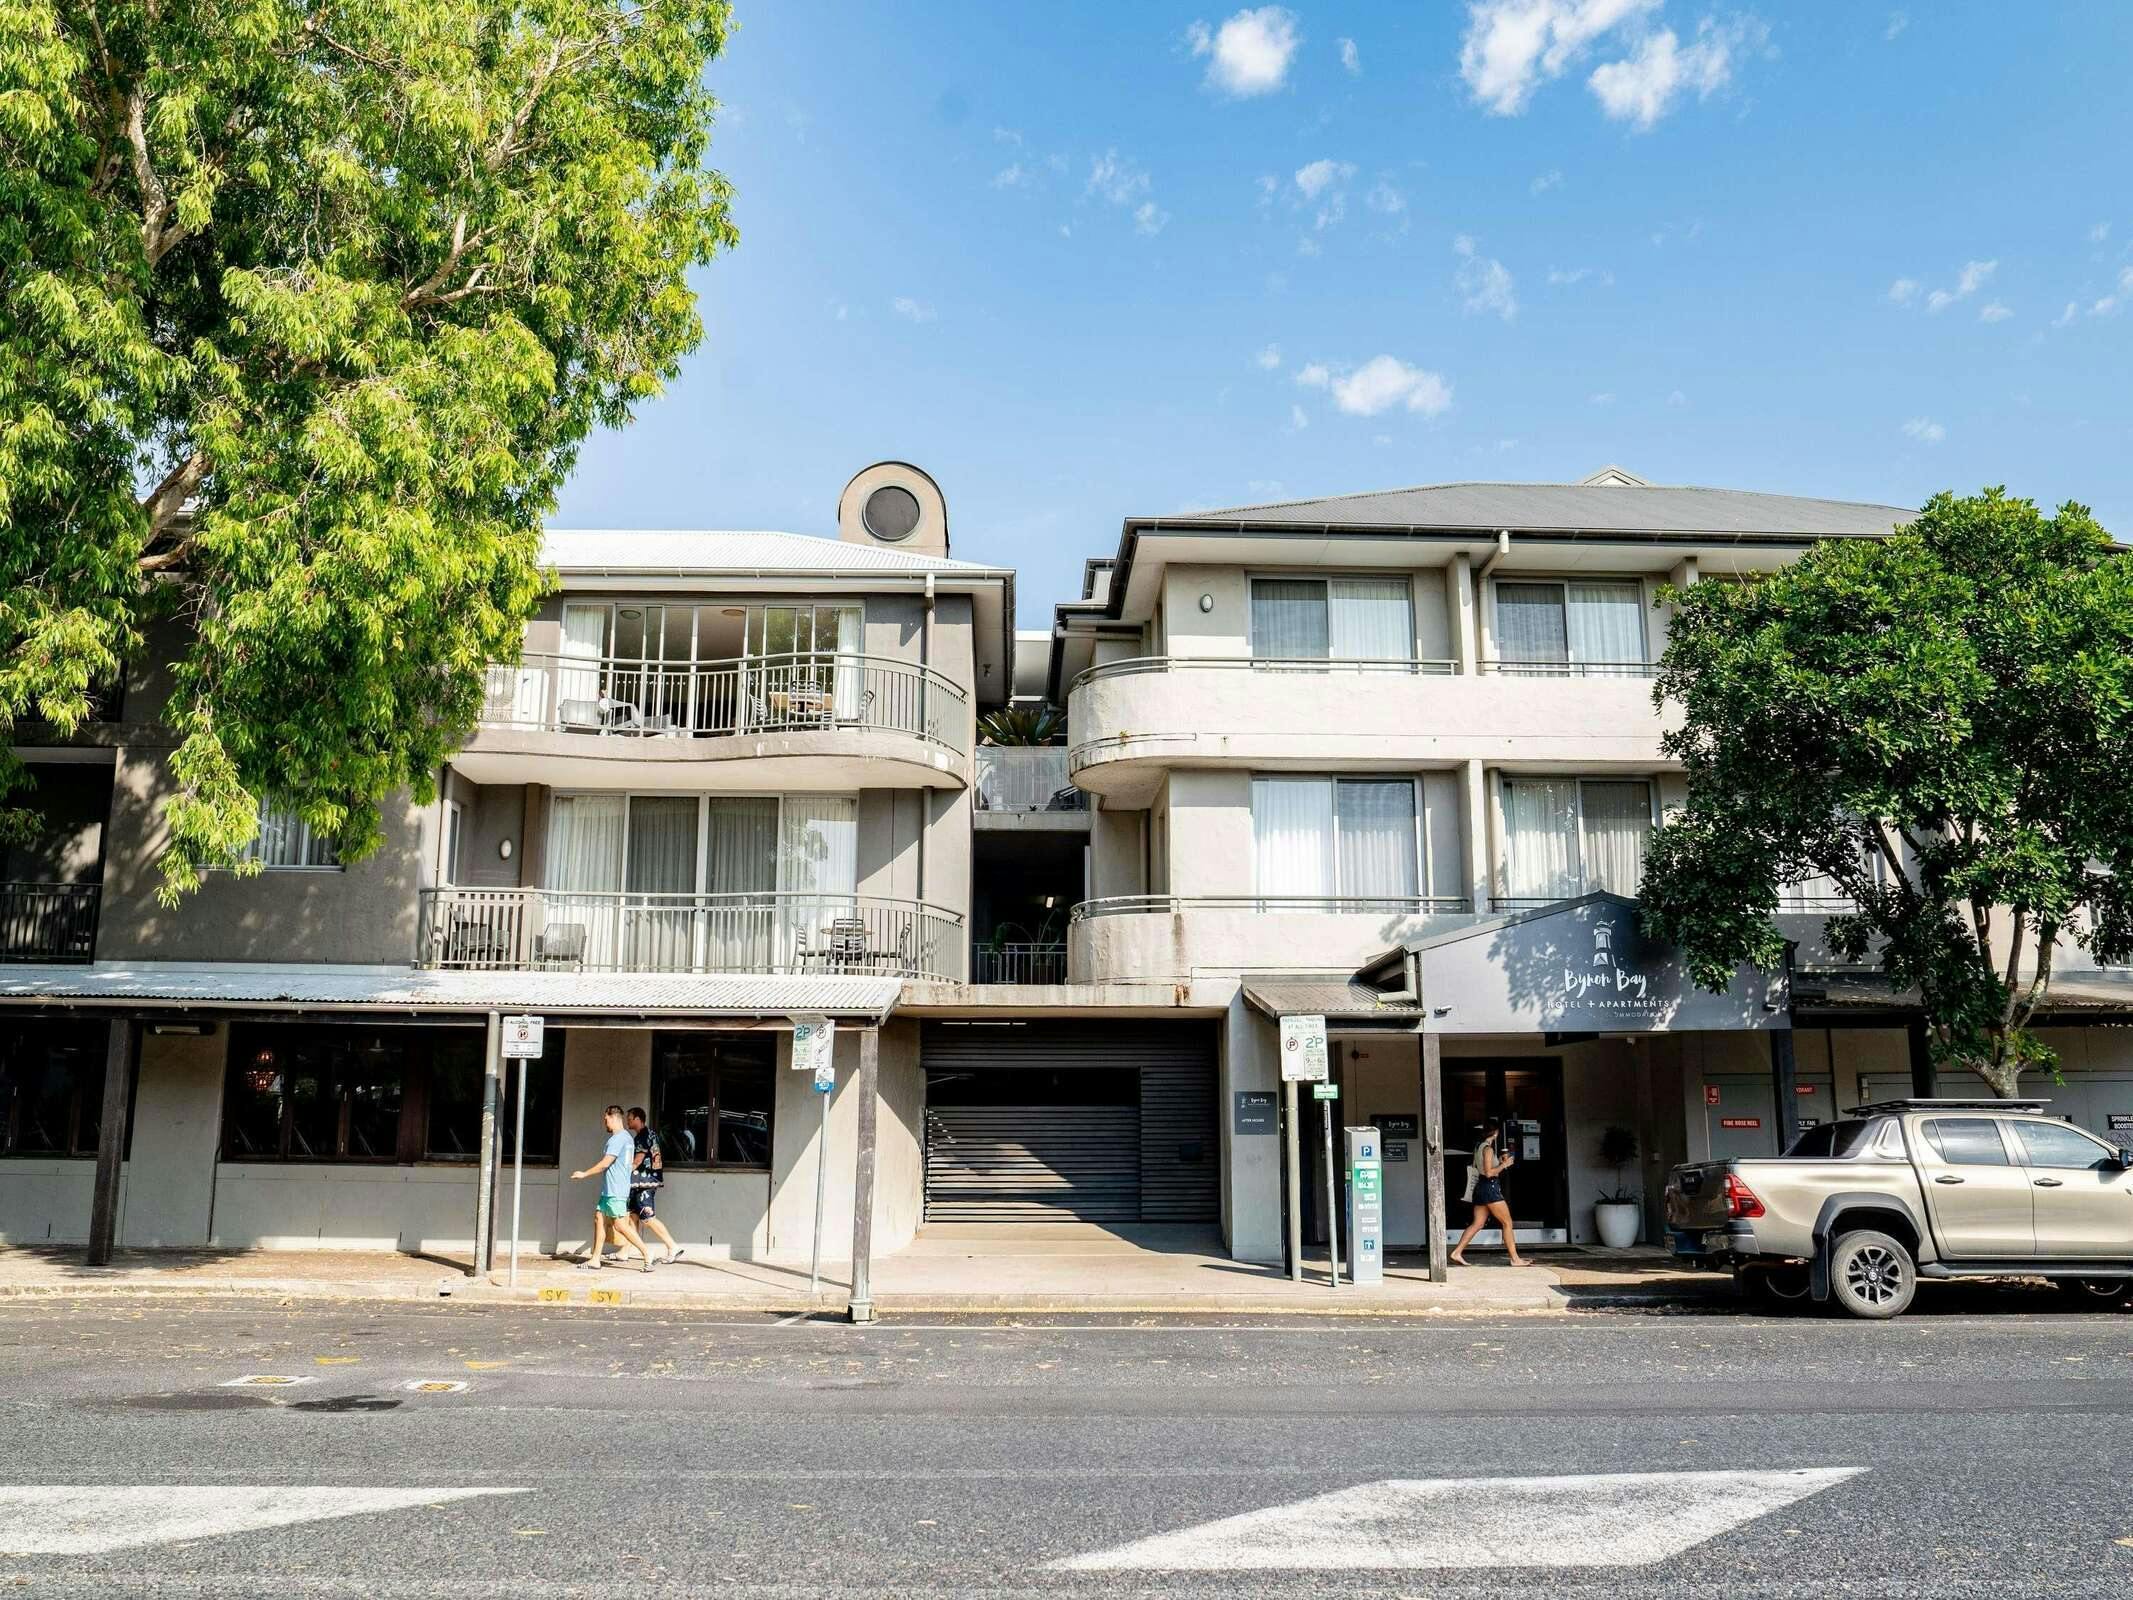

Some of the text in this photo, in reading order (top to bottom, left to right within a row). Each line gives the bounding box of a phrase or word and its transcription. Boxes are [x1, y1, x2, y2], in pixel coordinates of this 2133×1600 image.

[1564, 967, 1647, 999] Byron Bay
[1547, 1000, 1581, 1009] HOTEL
[1599, 1000, 1670, 1009] APARTMENTS
[795, 1027, 811, 1038] 2P
[1305, 1037, 1324, 1048] 2P
